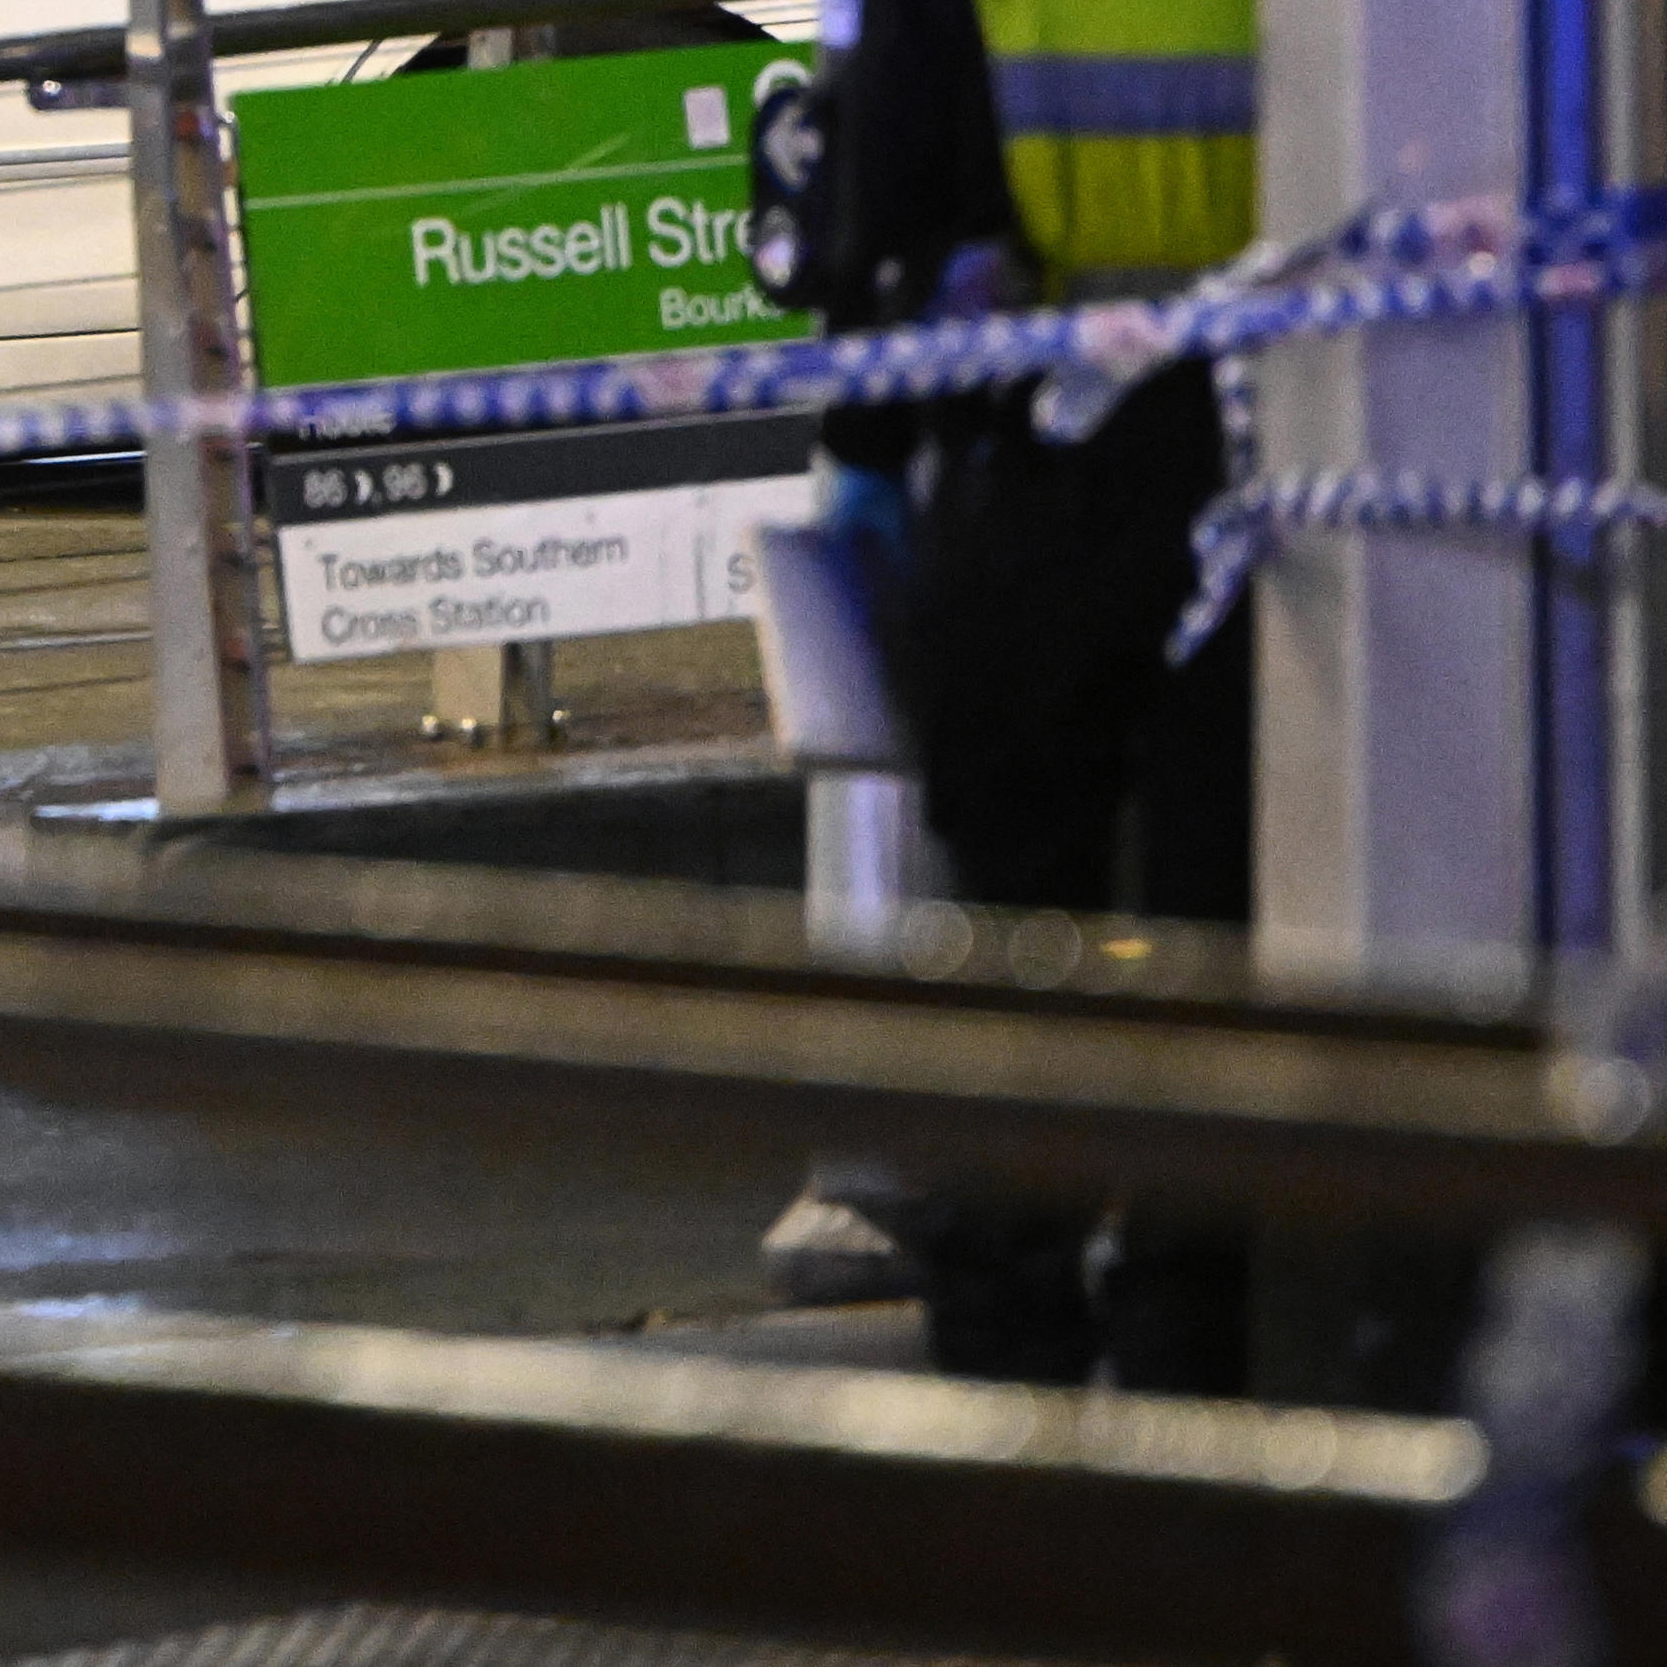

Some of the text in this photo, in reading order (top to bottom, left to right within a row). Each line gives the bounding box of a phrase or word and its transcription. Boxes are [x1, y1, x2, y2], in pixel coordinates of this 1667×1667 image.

[411, 201, 631, 286] Russell
[320, 535, 628, 590] Towards Southern
[429, 593, 549, 635] Station
